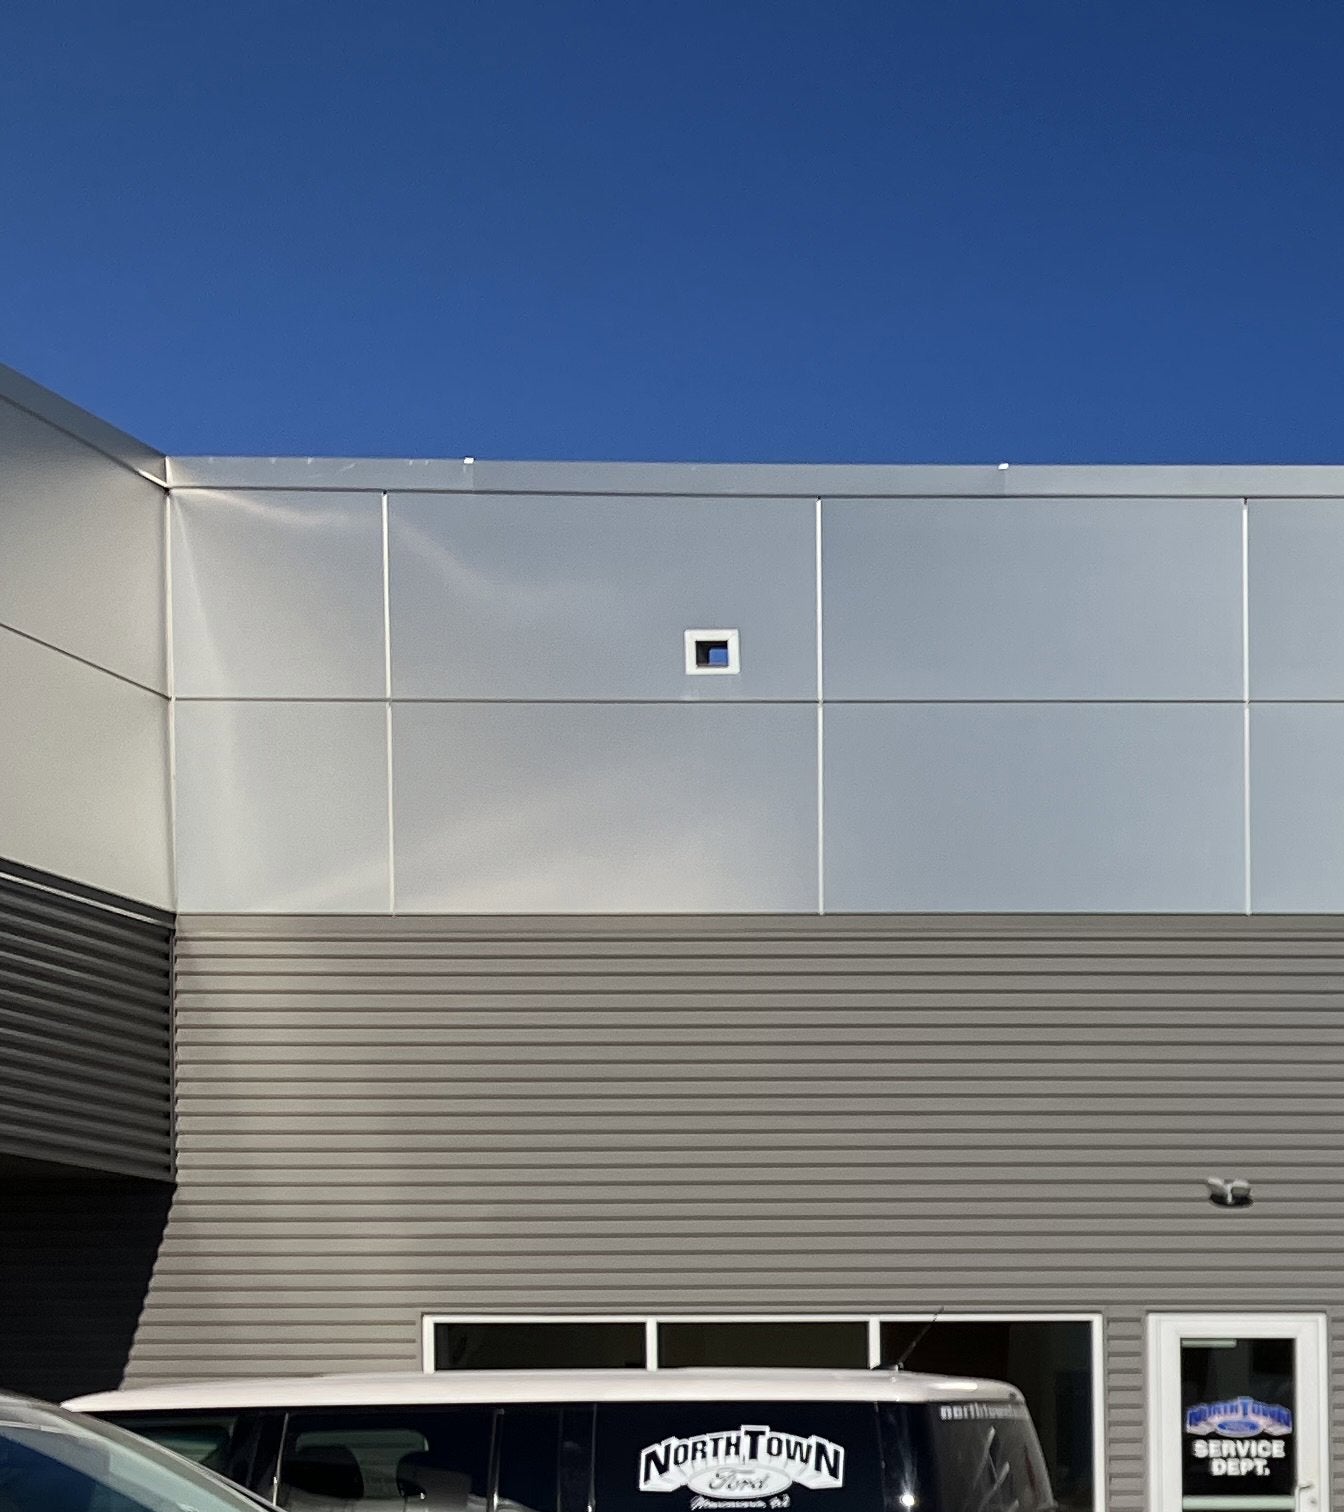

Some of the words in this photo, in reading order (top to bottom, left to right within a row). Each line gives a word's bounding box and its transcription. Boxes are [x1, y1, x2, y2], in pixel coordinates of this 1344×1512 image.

[1193, 1440, 1286, 1458] SERVICE
[1211, 1458, 1271, 1476] DEPT.
[708, 1467, 771, 1490] Ford
